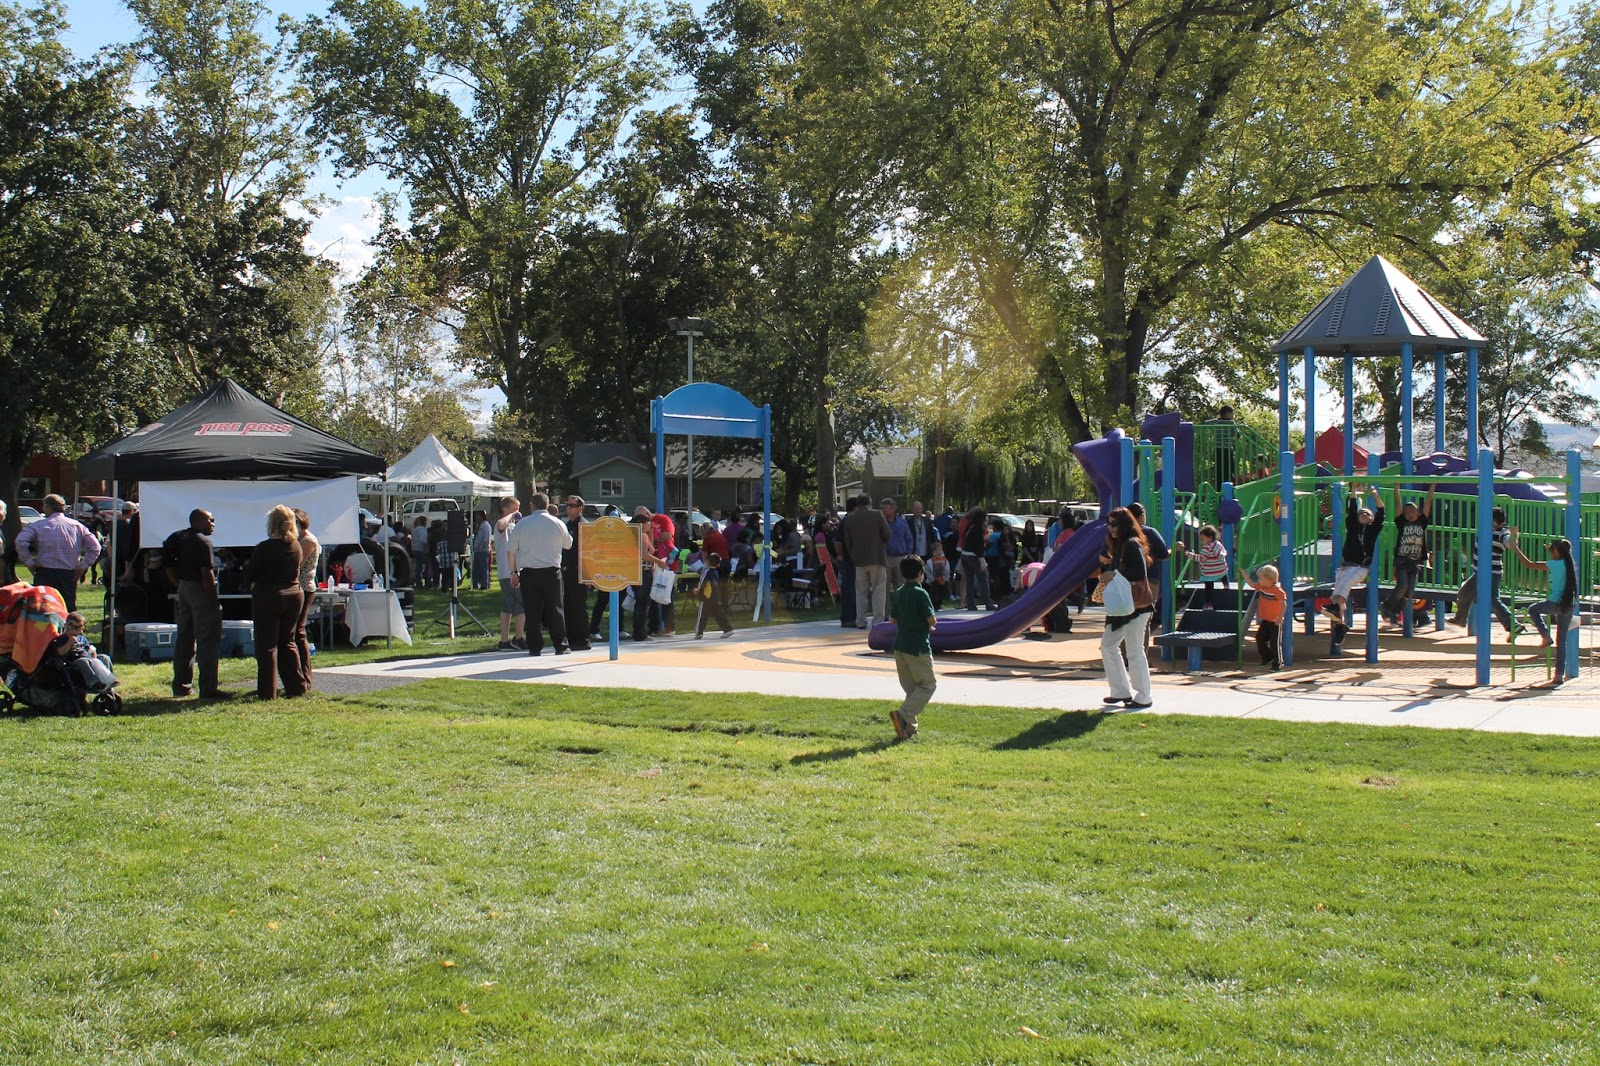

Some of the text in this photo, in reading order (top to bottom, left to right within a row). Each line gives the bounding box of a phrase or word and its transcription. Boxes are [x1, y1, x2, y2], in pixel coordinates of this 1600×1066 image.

[199, 422, 242, 436] TIRE
[365, 483, 436, 493] FAC PAINTING
